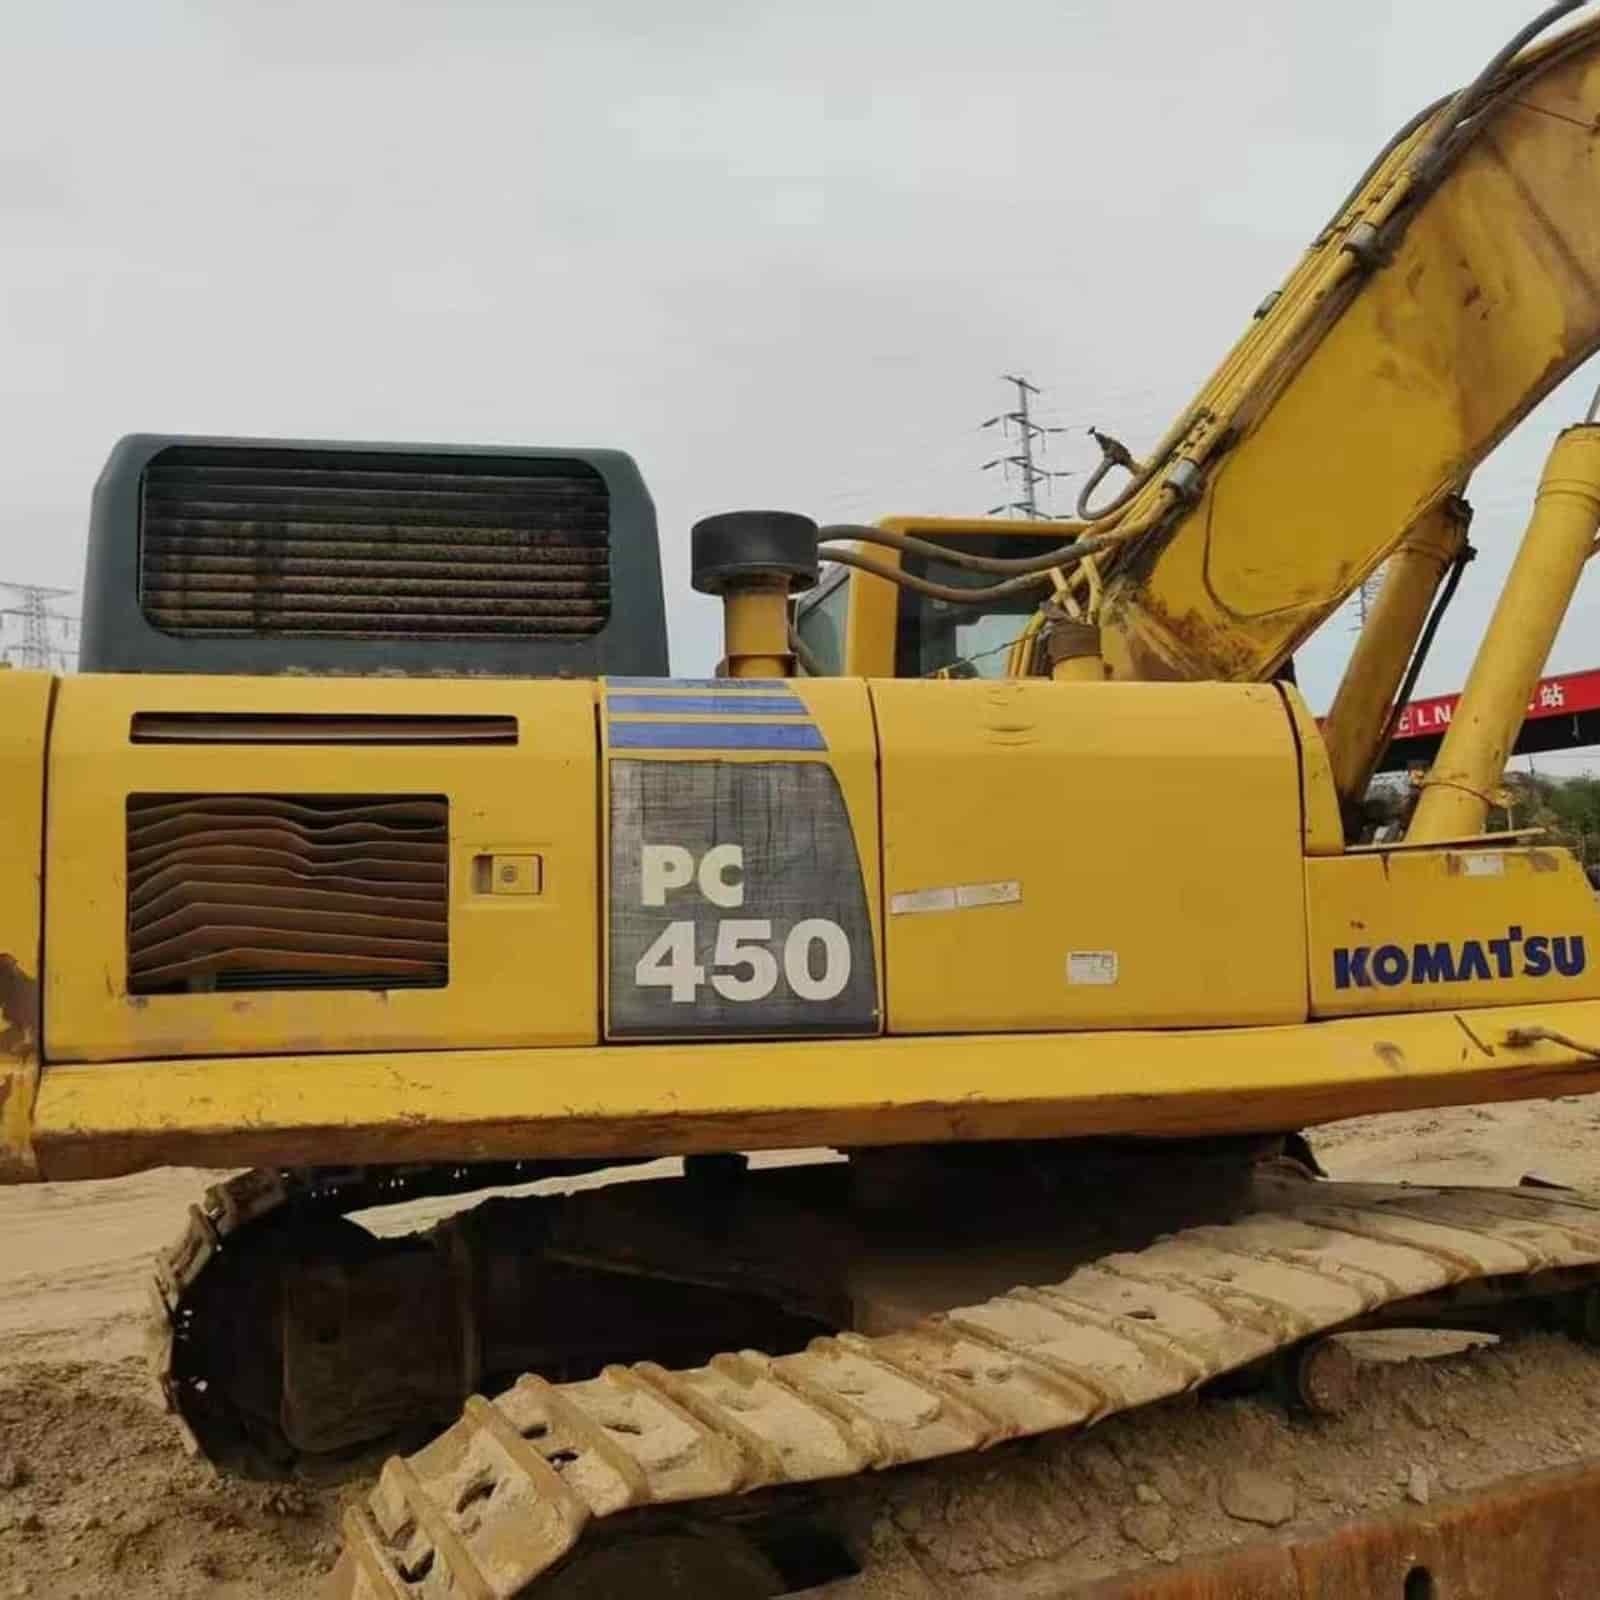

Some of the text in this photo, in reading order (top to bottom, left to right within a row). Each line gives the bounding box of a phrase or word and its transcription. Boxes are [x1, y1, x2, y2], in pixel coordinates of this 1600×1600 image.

[641, 843, 744, 908] PC
[635, 918, 851, 1003] 450
[1333, 925, 1586, 990] KOMATSU
